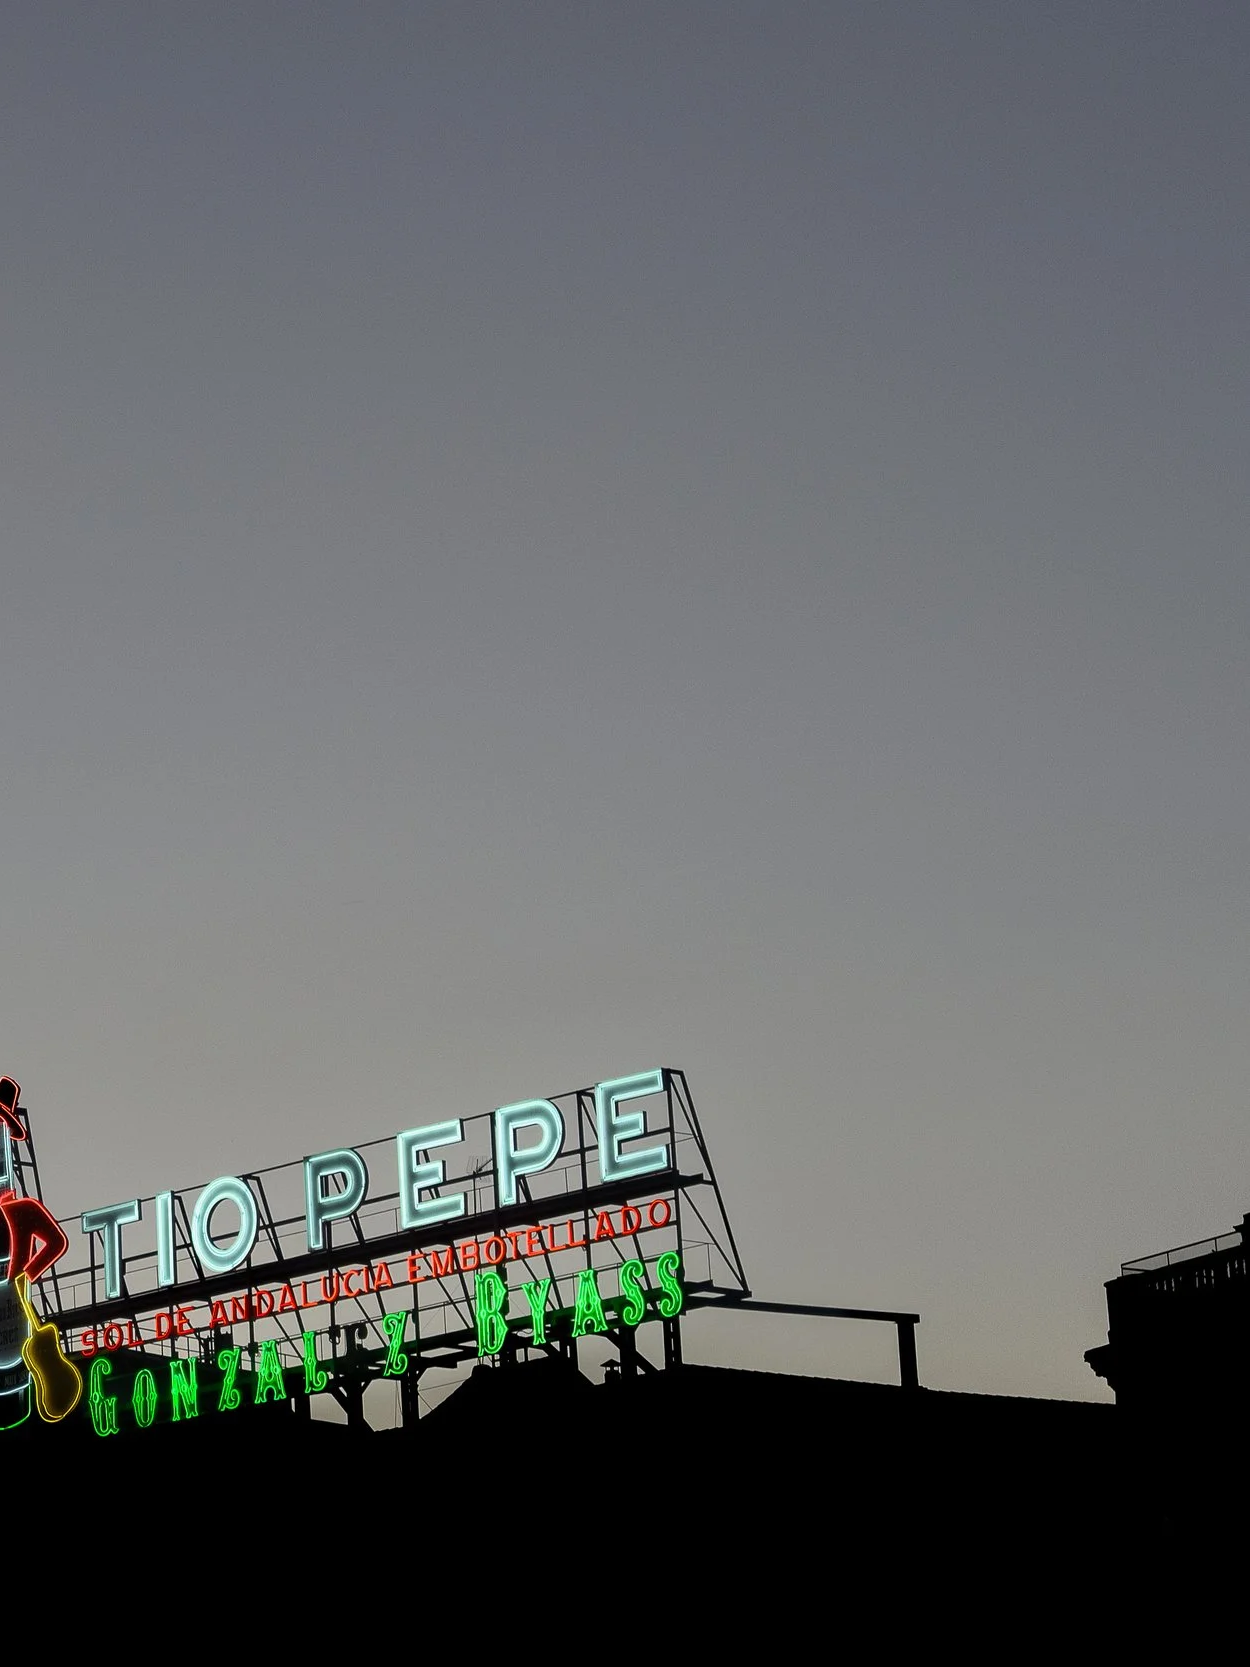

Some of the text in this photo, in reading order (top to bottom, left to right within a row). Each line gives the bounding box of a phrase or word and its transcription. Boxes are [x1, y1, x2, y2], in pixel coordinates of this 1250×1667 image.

[81, 1068, 669, 1299] TIO PEPE
[81, 1199, 670, 1357] SOL DE ANDALUCIA EMBOTELLADO
[89, 1251, 683, 1436] GONZALZ BYASS
